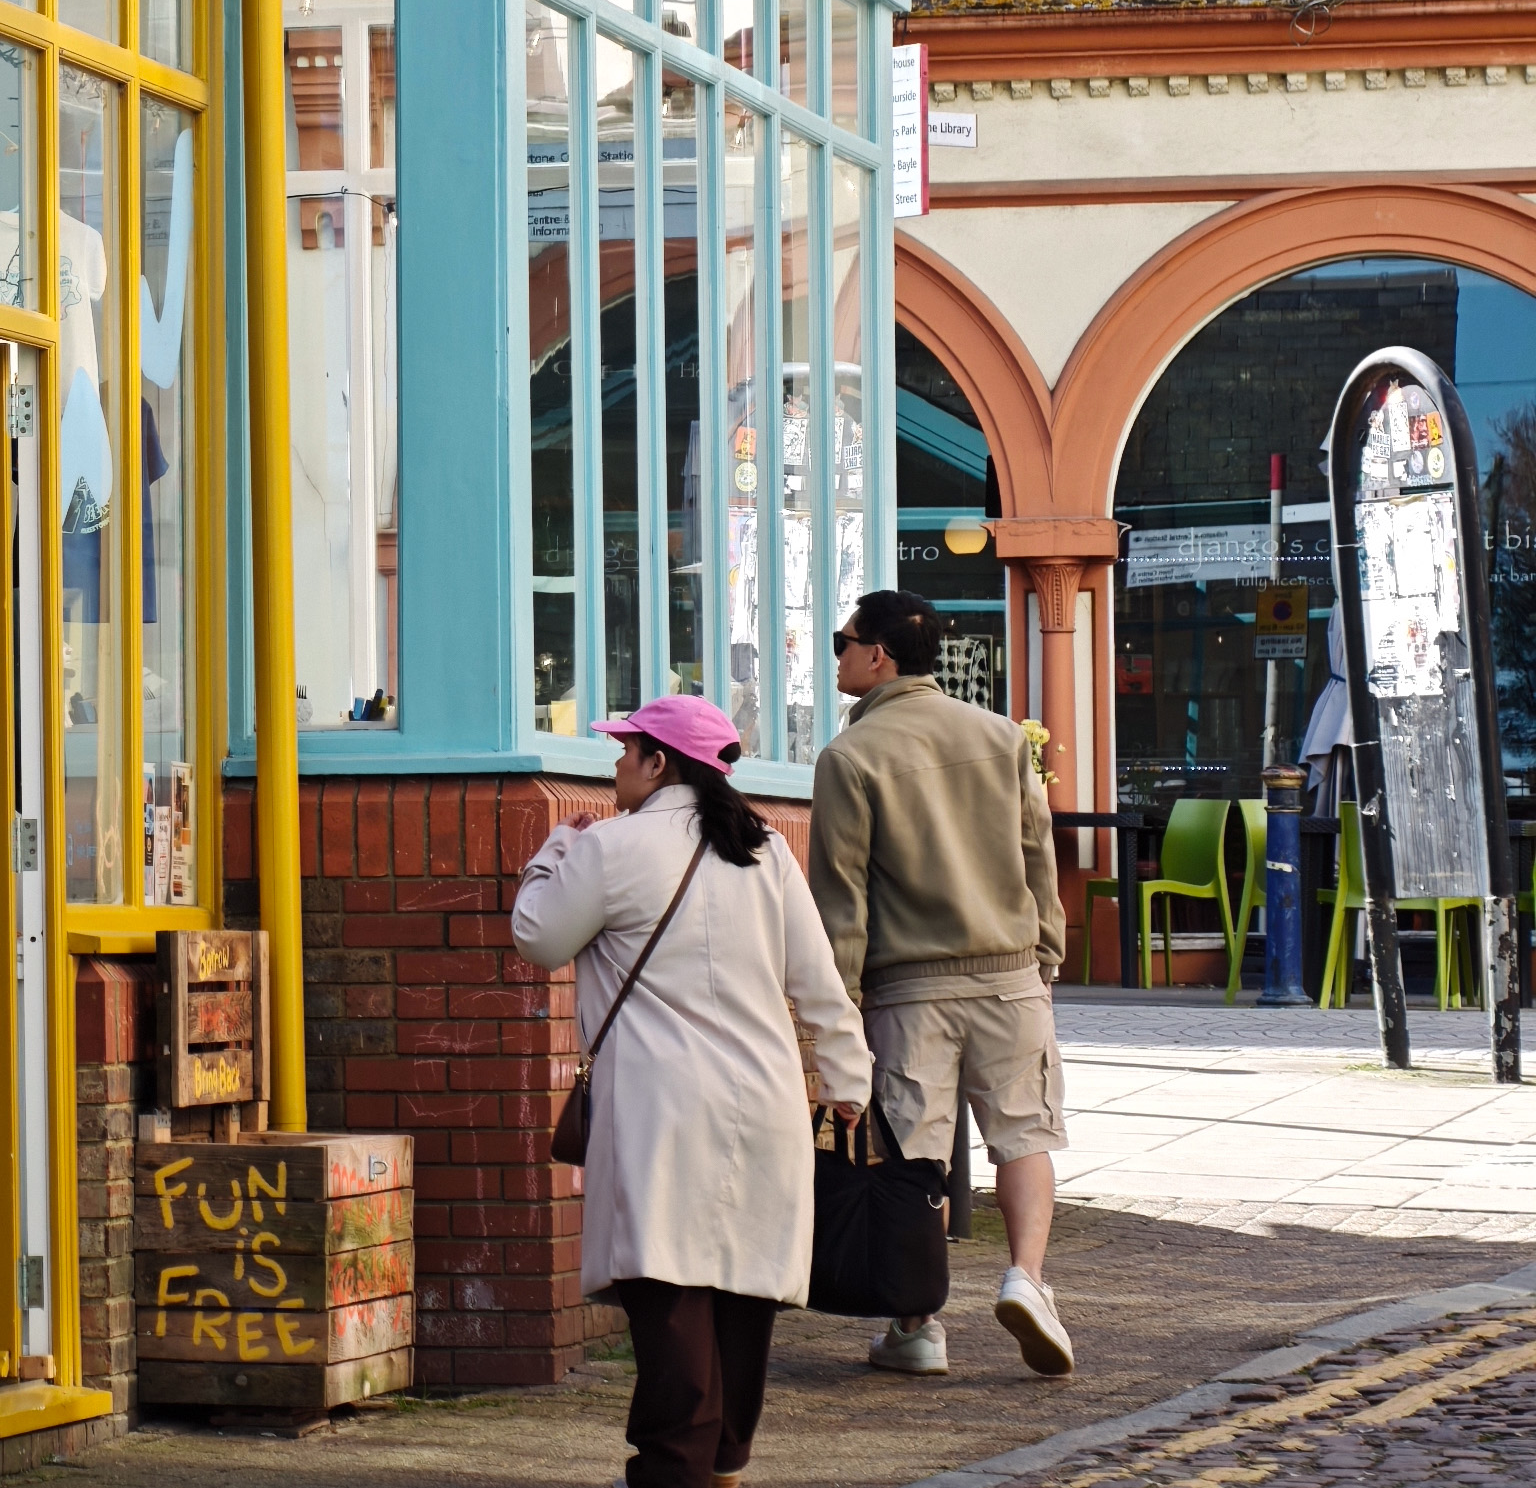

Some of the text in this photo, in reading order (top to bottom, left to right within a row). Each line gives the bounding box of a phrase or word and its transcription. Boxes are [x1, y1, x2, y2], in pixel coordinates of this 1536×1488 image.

[901, 124, 917, 137] Park
[940, 122, 973, 138] Library
[897, 157, 918, 173] Bayle
[895, 193, 918, 205] Street
[1177, 526, 1304, 574] django's
[199, 939, 230, 982] Borrow
[194, 1056, 241, 1100] Bring Back
[154, 1156, 288, 1231] FUN
[155, 1265, 316, 1362] FREE
